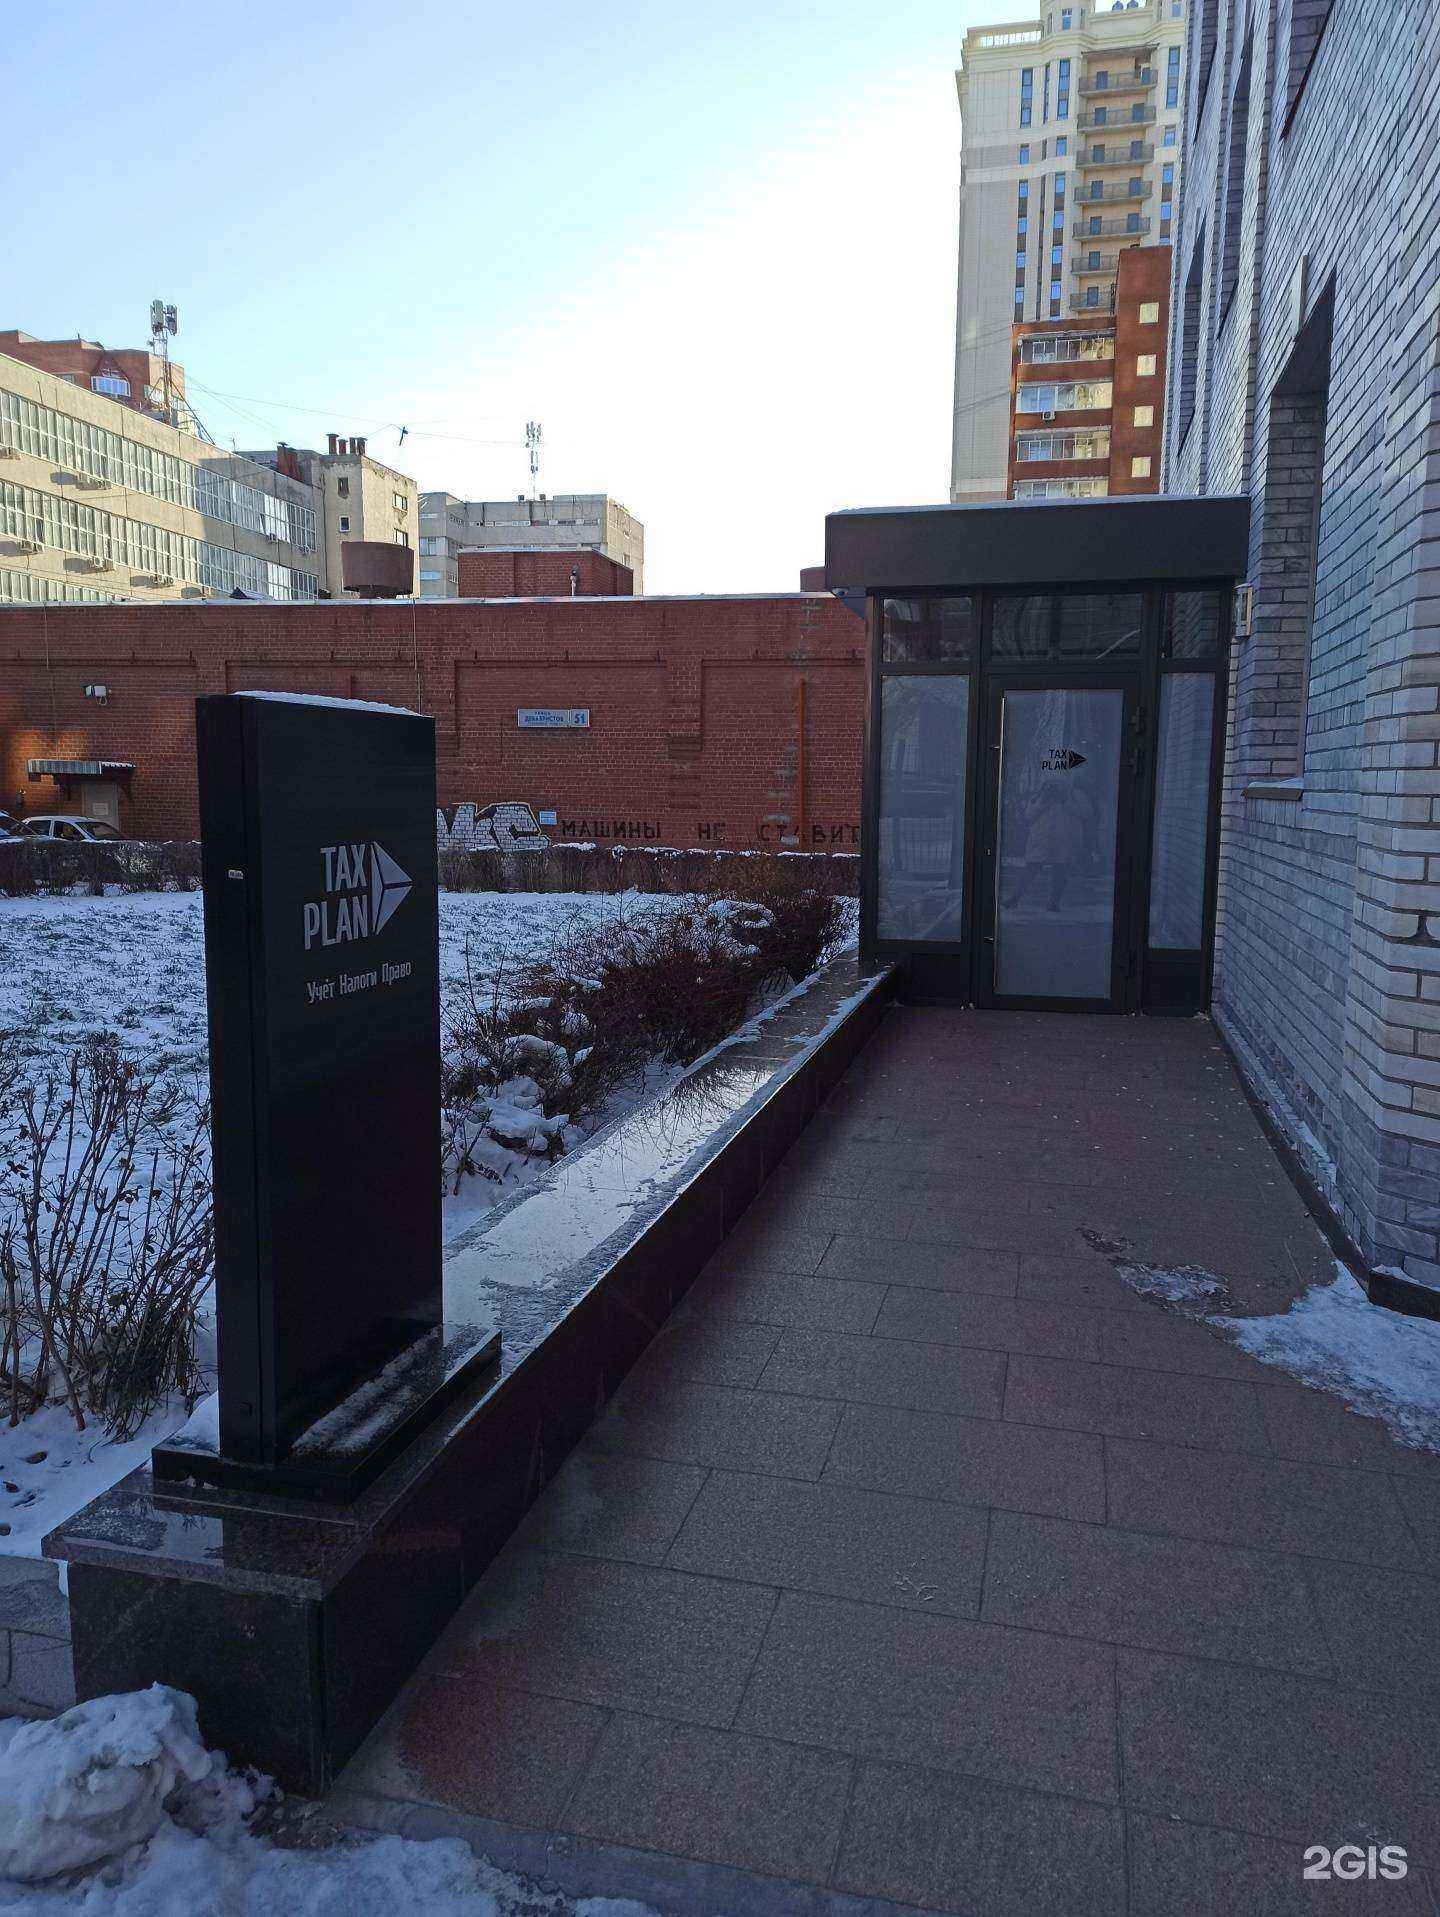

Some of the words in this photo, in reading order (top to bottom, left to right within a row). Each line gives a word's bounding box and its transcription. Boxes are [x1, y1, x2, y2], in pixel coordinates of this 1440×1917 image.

[574, 713, 586, 724] 51
[1041, 760, 1067, 770] PLAN
[1048, 749, 1067, 759] TAX
[561, 819, 661, 838] МАШИНЫ
[697, 822, 725, 841] НЕ
[320, 844, 367, 892] TAX
[303, 895, 368, 950] PLAN
[339, 970, 378, 995] Налоги
[382, 962, 411, 985] Право
